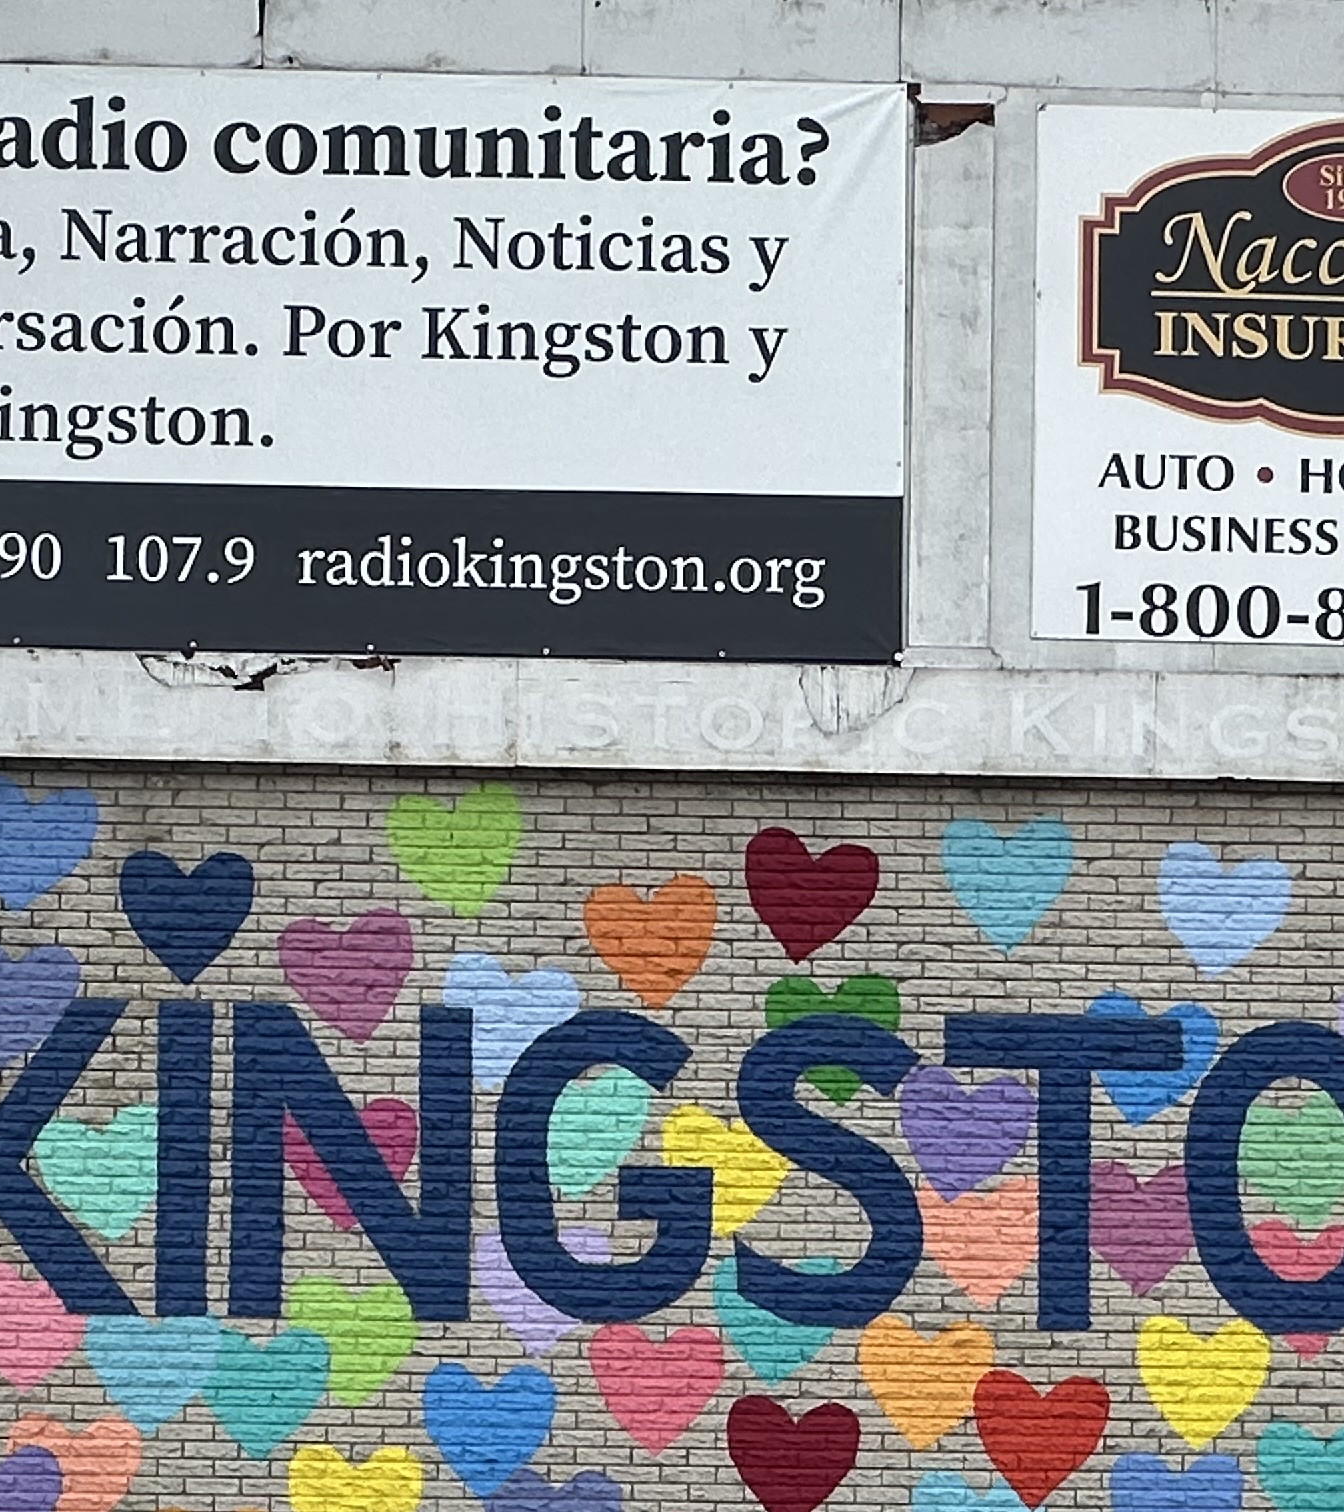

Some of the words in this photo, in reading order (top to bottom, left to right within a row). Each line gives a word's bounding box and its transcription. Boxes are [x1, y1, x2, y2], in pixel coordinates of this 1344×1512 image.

[213, 104, 831, 186] comunitaria?
[59, 207, 431, 283] Narración,
[452, 214, 731, 275] Noticias
[748, 233, 790, 292] y
[282, 303, 401, 359] Por
[421, 303, 731, 378] Kingston
[747, 324, 789, 384] y
[1098, 453, 1236, 492] AUTO
[105, 535, 256, 584] 107.9
[297, 536, 827, 610] radiokingston.org
[1113, 514, 1340, 556] BUSINESS
